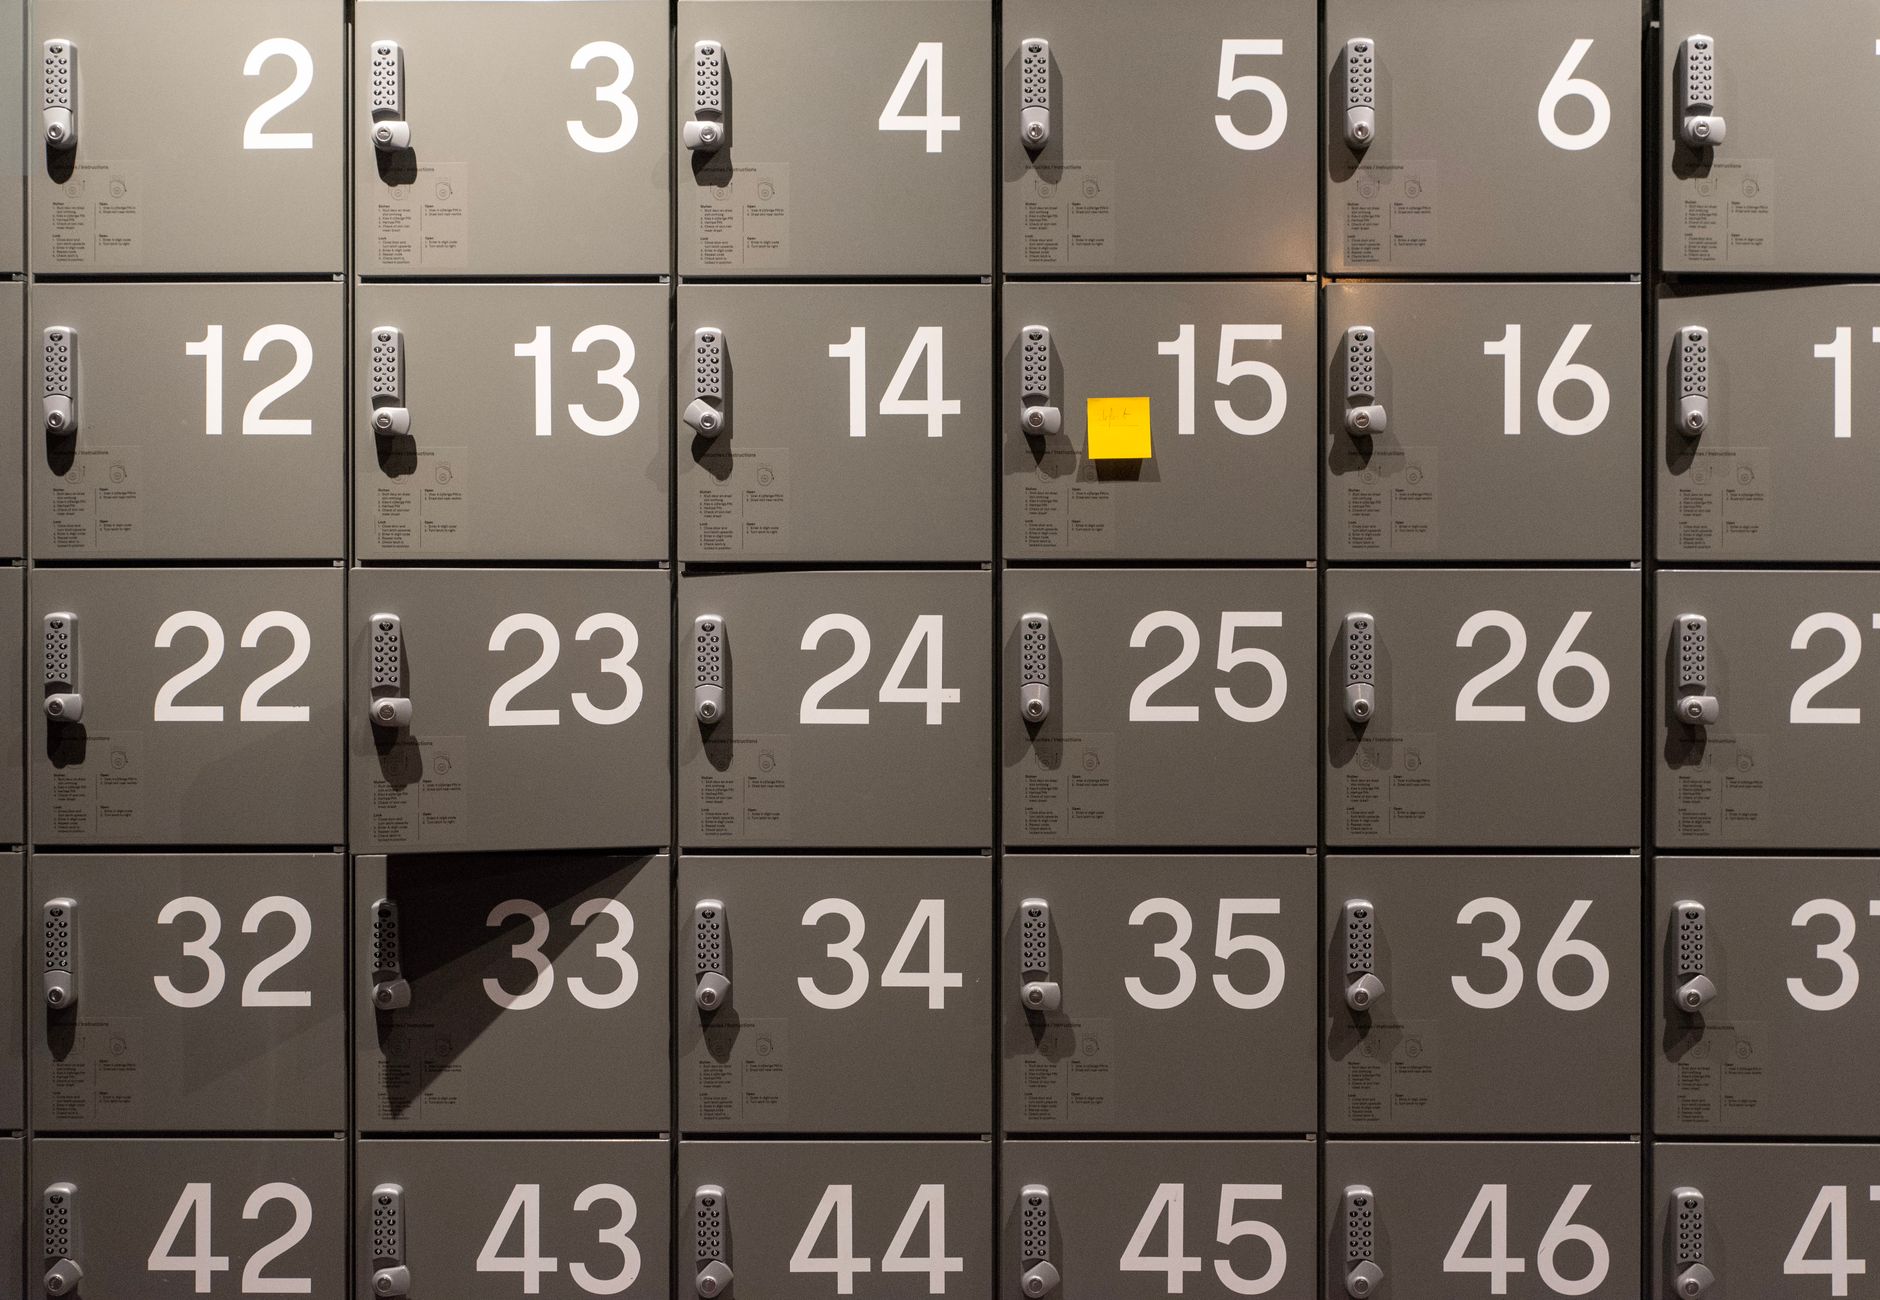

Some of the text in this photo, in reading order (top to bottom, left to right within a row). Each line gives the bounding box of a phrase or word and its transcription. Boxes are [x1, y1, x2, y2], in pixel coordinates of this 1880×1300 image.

[244, 38, 313, 149] 2
[567, 41, 638, 153] 3
[879, 42, 960, 153] 4
[1215, 39, 1287, 150] 5
[1538, 39, 1610, 150] 6
[186, 324, 313, 435] 12
[515, 325, 639, 436] 13
[829, 326, 960, 437] 14
[1158, 324, 1287, 435] 15
[1484, 324, 1610, 435] 16
[1814, 327, 1880, 438] 1
[154, 611, 310, 721] 22
[489, 613, 643, 726] 23
[800, 613, 960, 725] 24
[1129, 611, 1287, 722] 25
[1456, 610, 1610, 722] 26
[1790, 612, 1880, 724] 2
[154, 896, 311, 1008] 32
[483, 898, 639, 1010] 33
[798, 898, 962, 1009] 34
[1125, 898, 1285, 1009] 35
[1451, 897, 1609, 1011] 36
[1787, 899, 1880, 1011] 3
[148, 1182, 312, 1293] 42
[476, 1184, 641, 1295] 43
[790, 1184, 963, 1294] 44
[1120, 1183, 1286, 1295] 45
[1443, 1184, 1609, 1295] 46
[1784, 1185, 1880, 1296] 4
